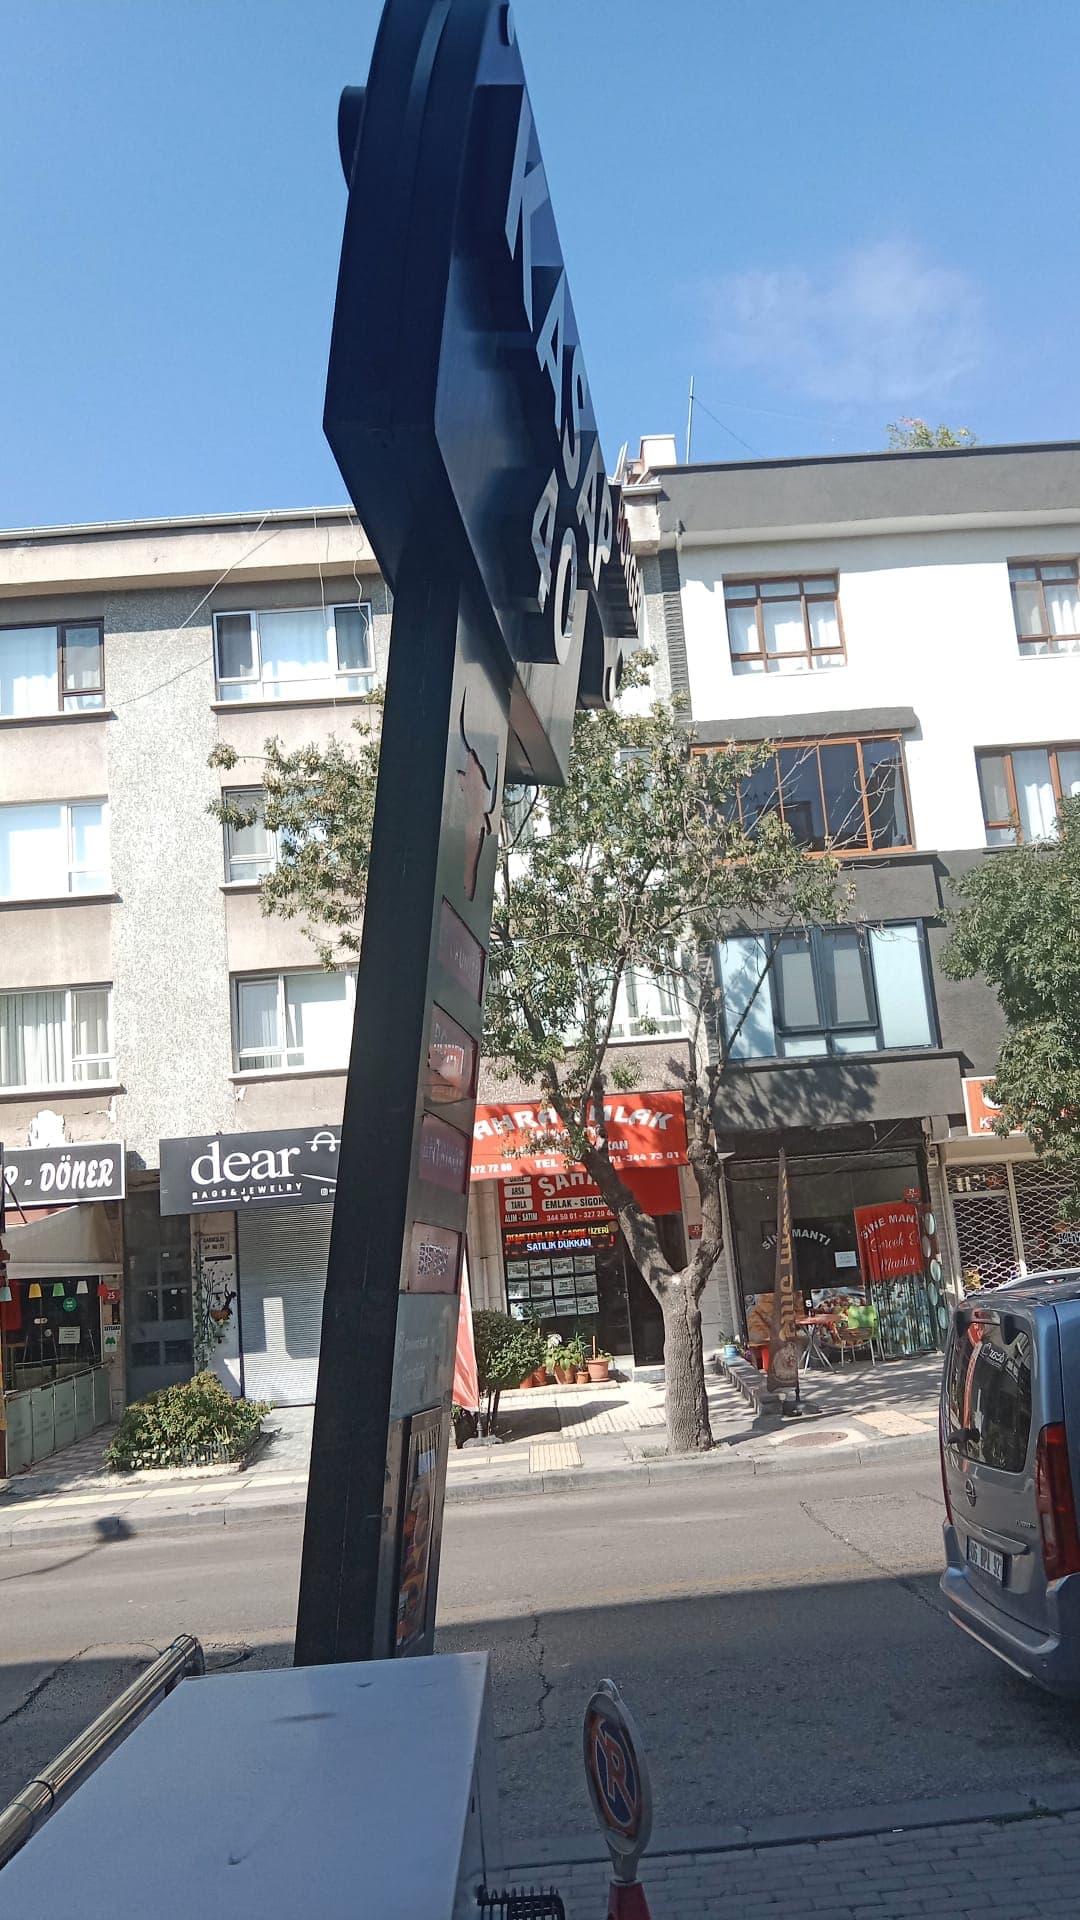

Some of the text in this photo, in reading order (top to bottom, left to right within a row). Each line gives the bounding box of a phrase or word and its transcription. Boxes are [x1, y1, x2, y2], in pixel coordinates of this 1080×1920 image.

[473, 1106, 558, 1140] AHRA
[191, 1140, 301, 1185] dear
[535, 1159, 559, 1169] TEL
[40, 1154, 114, 1192] DÖNER
[538, 1172, 598, 1197] SAH
[545, 1199, 572, 1210] EMLAK
[888, 1213, 915, 1224] MAN
[791, 1228, 832, 1246] MANTI
[526, 1242, 557, 1252] SATILIK
